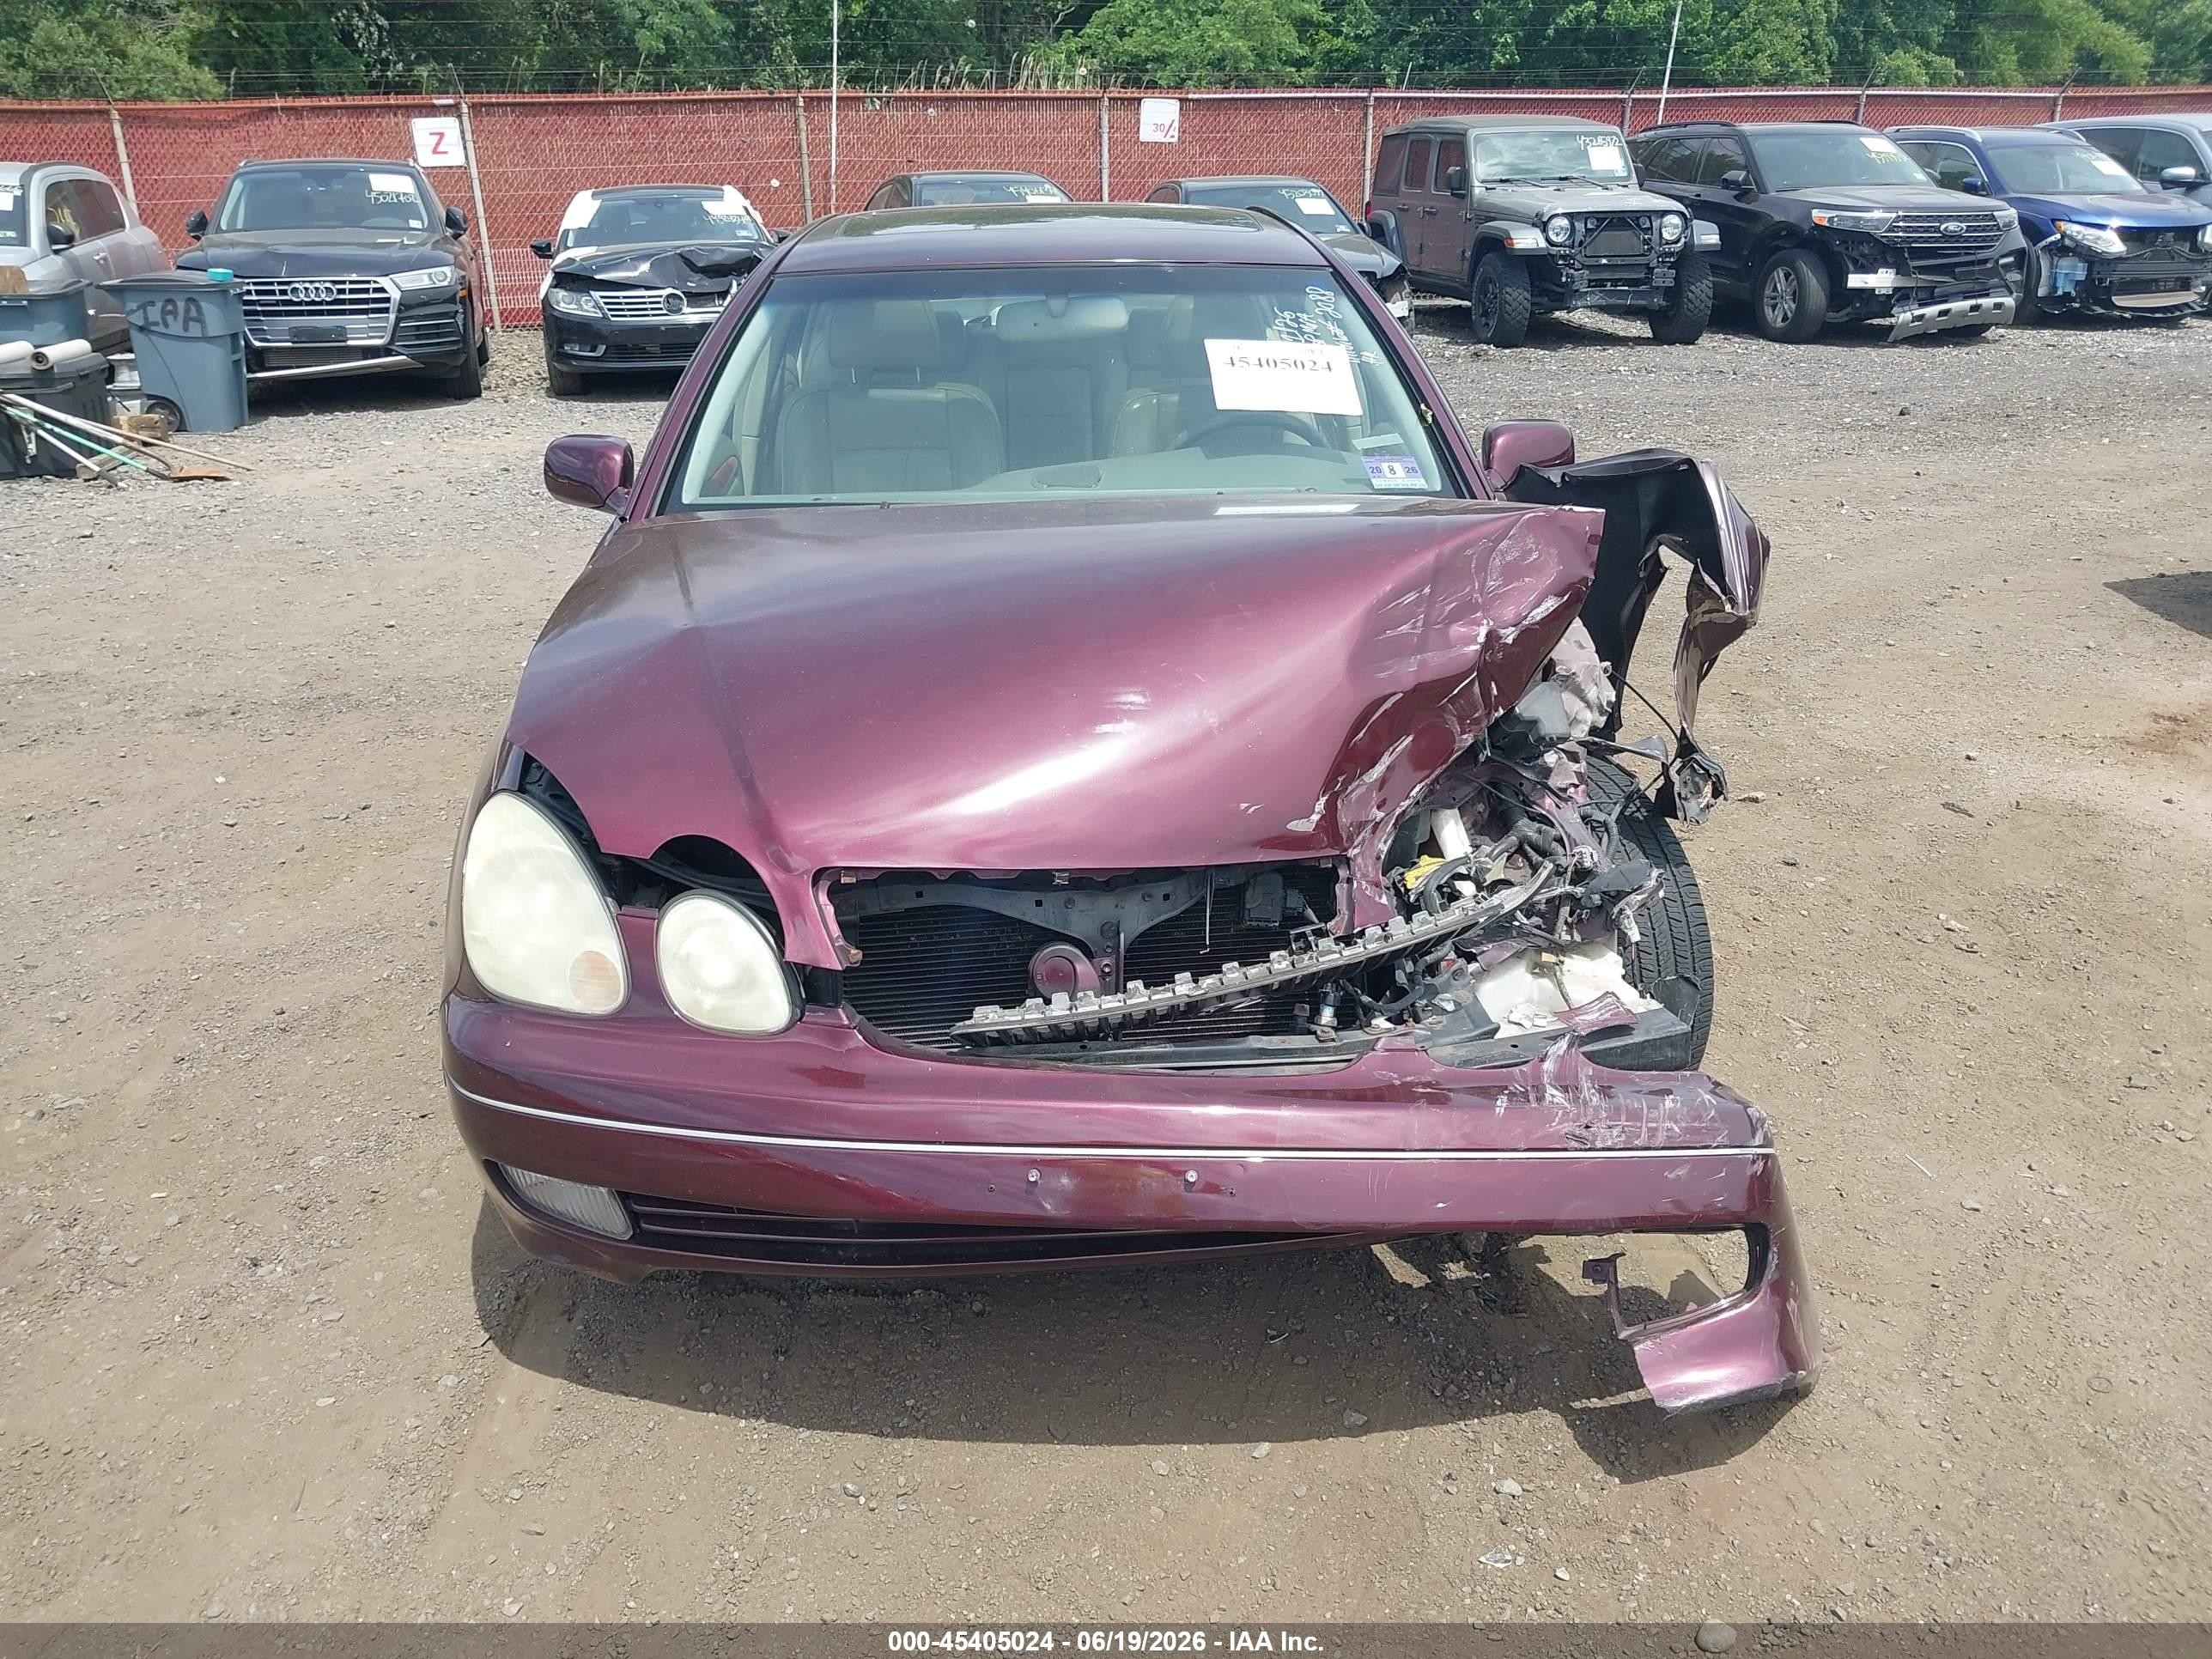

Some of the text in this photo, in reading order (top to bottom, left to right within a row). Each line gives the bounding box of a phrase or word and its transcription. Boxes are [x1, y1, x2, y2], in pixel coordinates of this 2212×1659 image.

[429, 131, 448, 155] Z
[128, 297, 208, 337] IAA
[1224, 356, 1333, 373] 45405024
[1369, 465, 1382, 474] 20
[1388, 465, 1396, 476] 8
